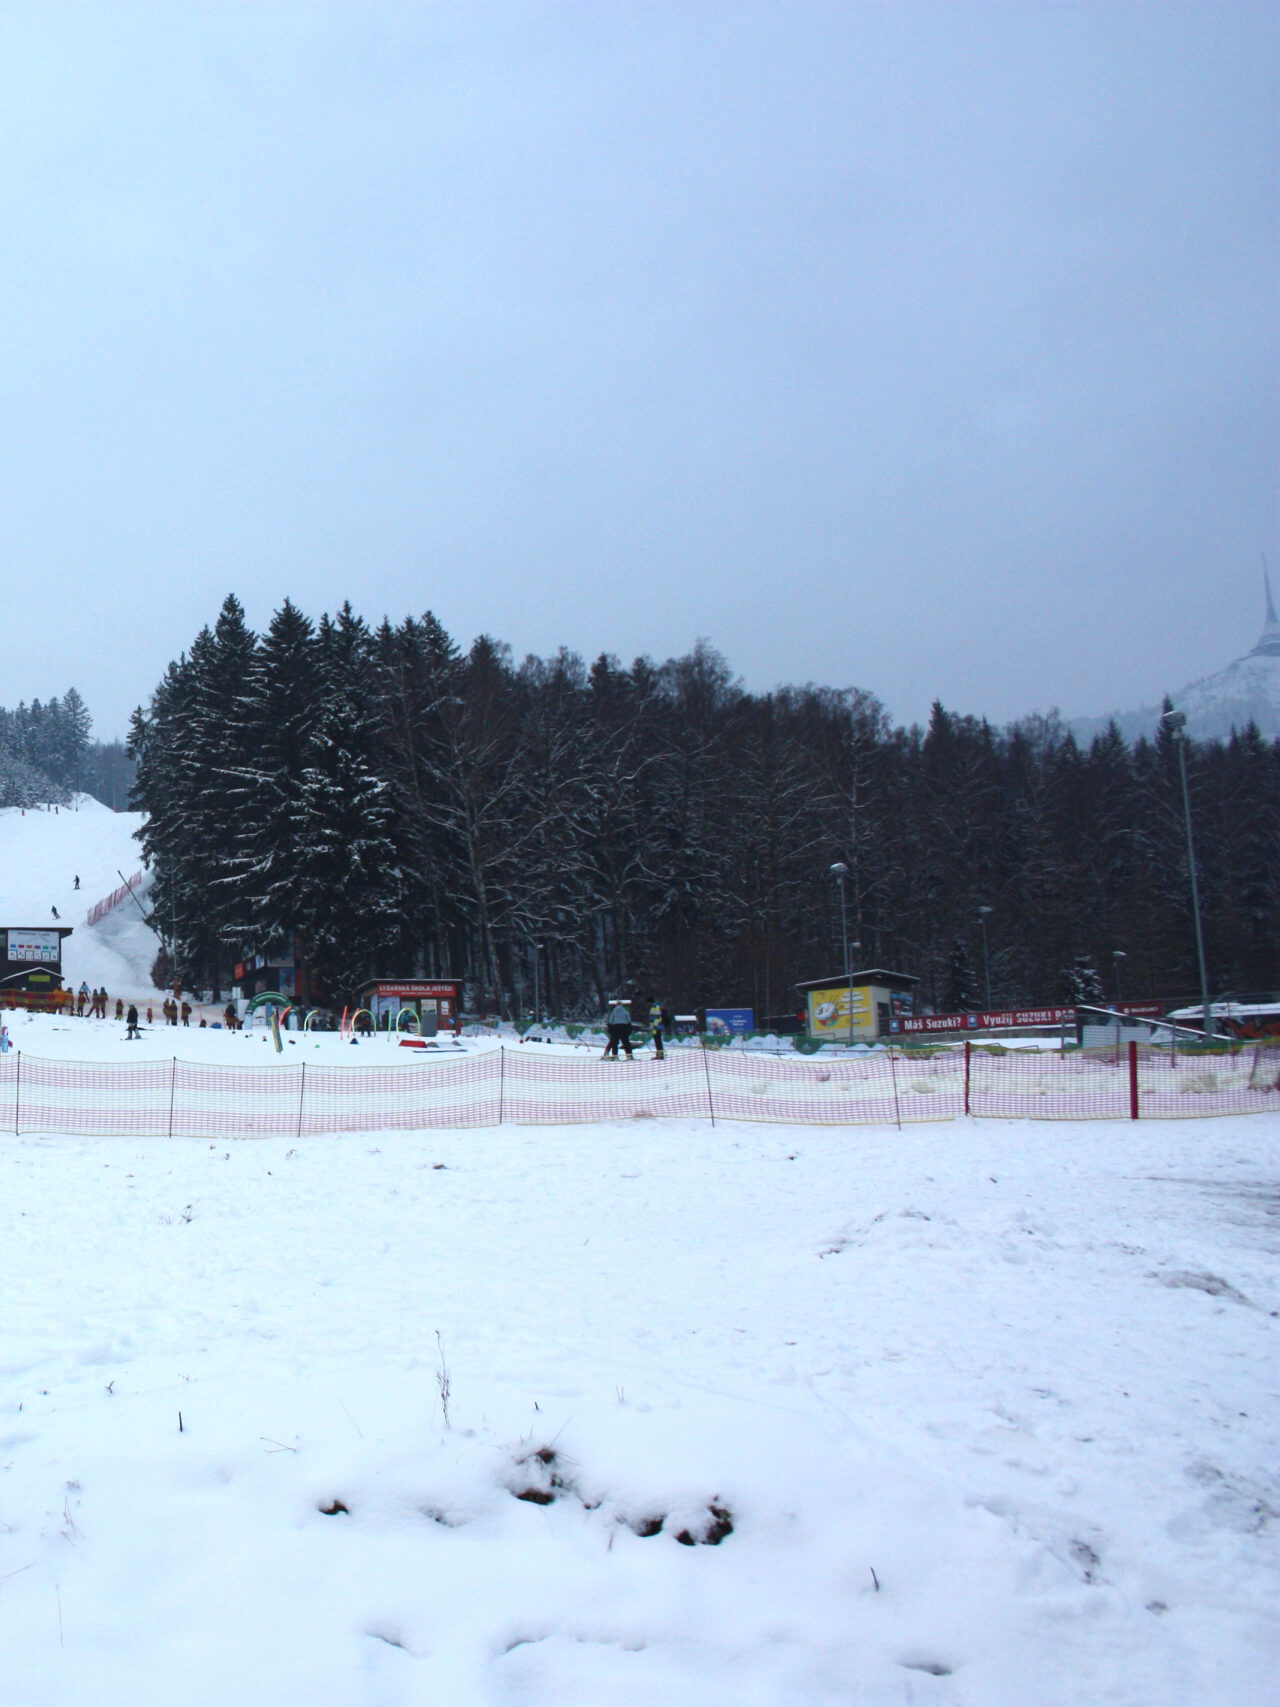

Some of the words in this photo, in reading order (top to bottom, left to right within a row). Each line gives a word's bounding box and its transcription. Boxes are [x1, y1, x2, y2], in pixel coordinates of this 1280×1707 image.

[904, 1019, 923, 1030] Máš
[926, 1017, 961, 1029] Suzuki?
[983, 1013, 1013, 1026] Využij
[1016, 1010, 1052, 1023] SUZUKI
